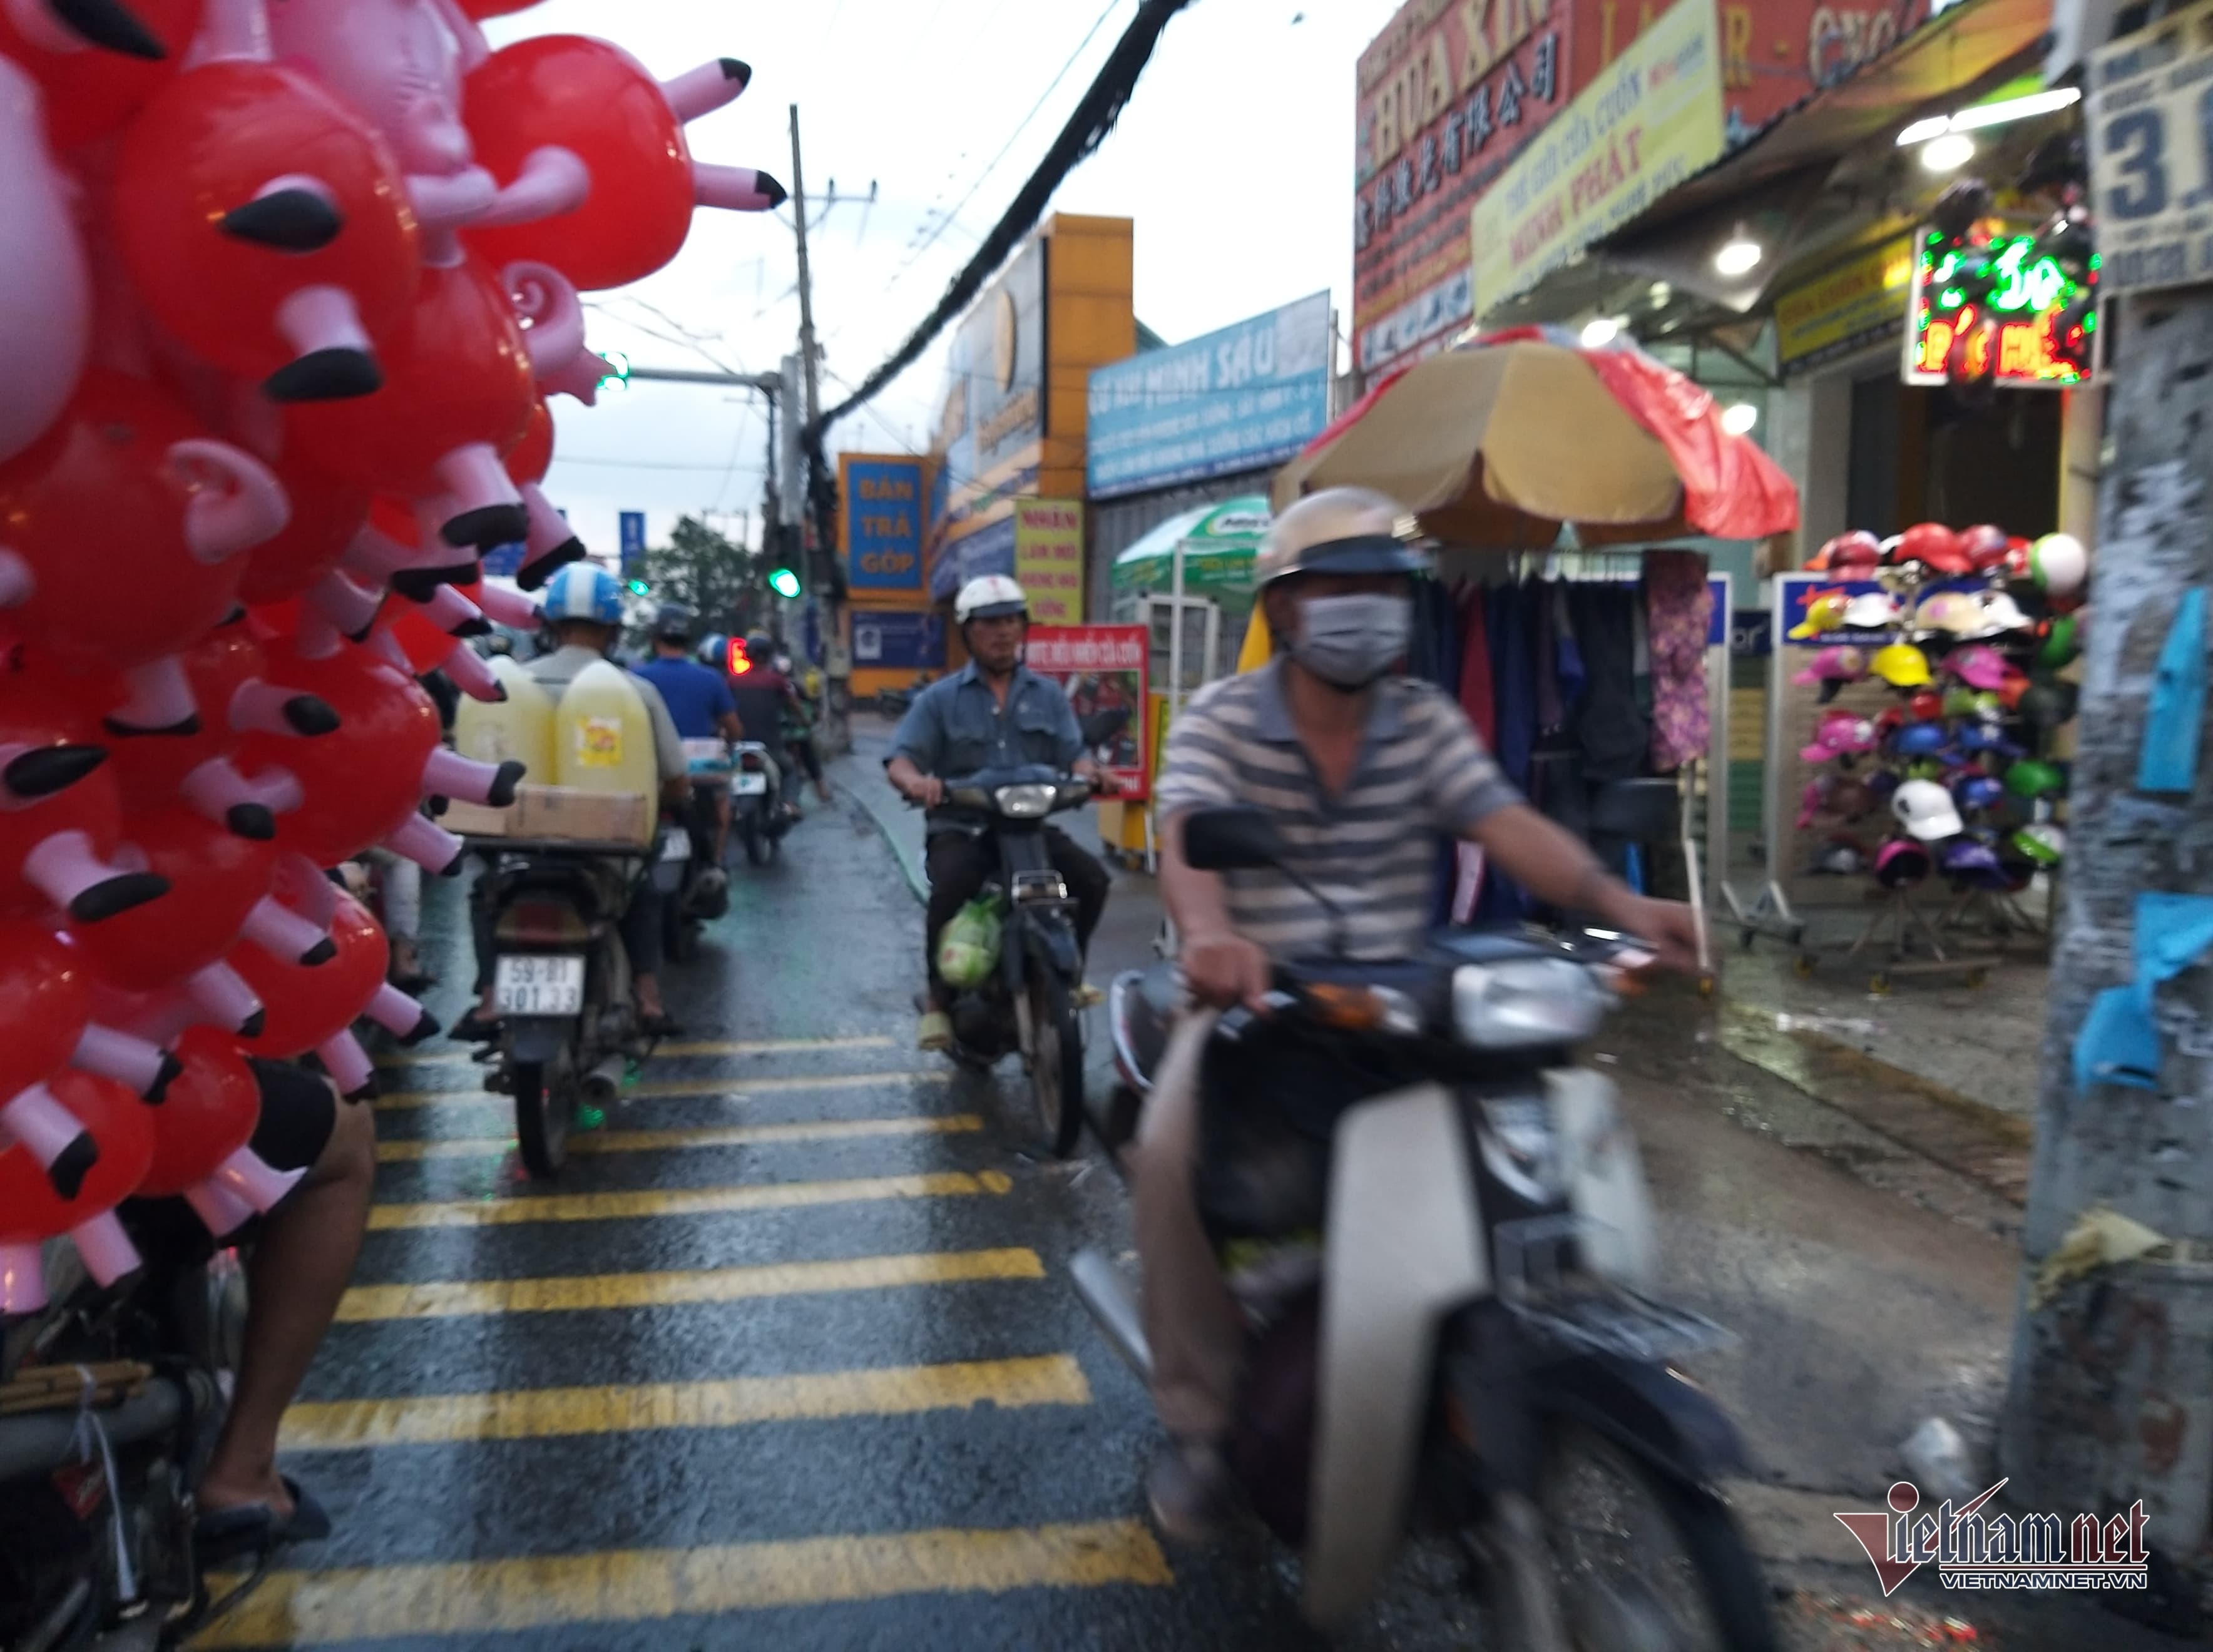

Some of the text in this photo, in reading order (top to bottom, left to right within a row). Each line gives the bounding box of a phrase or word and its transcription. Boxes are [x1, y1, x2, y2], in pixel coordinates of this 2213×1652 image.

[1570, 125, 1642, 217] PHÁT
[859, 474, 914, 499] BÁN
[861, 510, 912, 538] TRẢ
